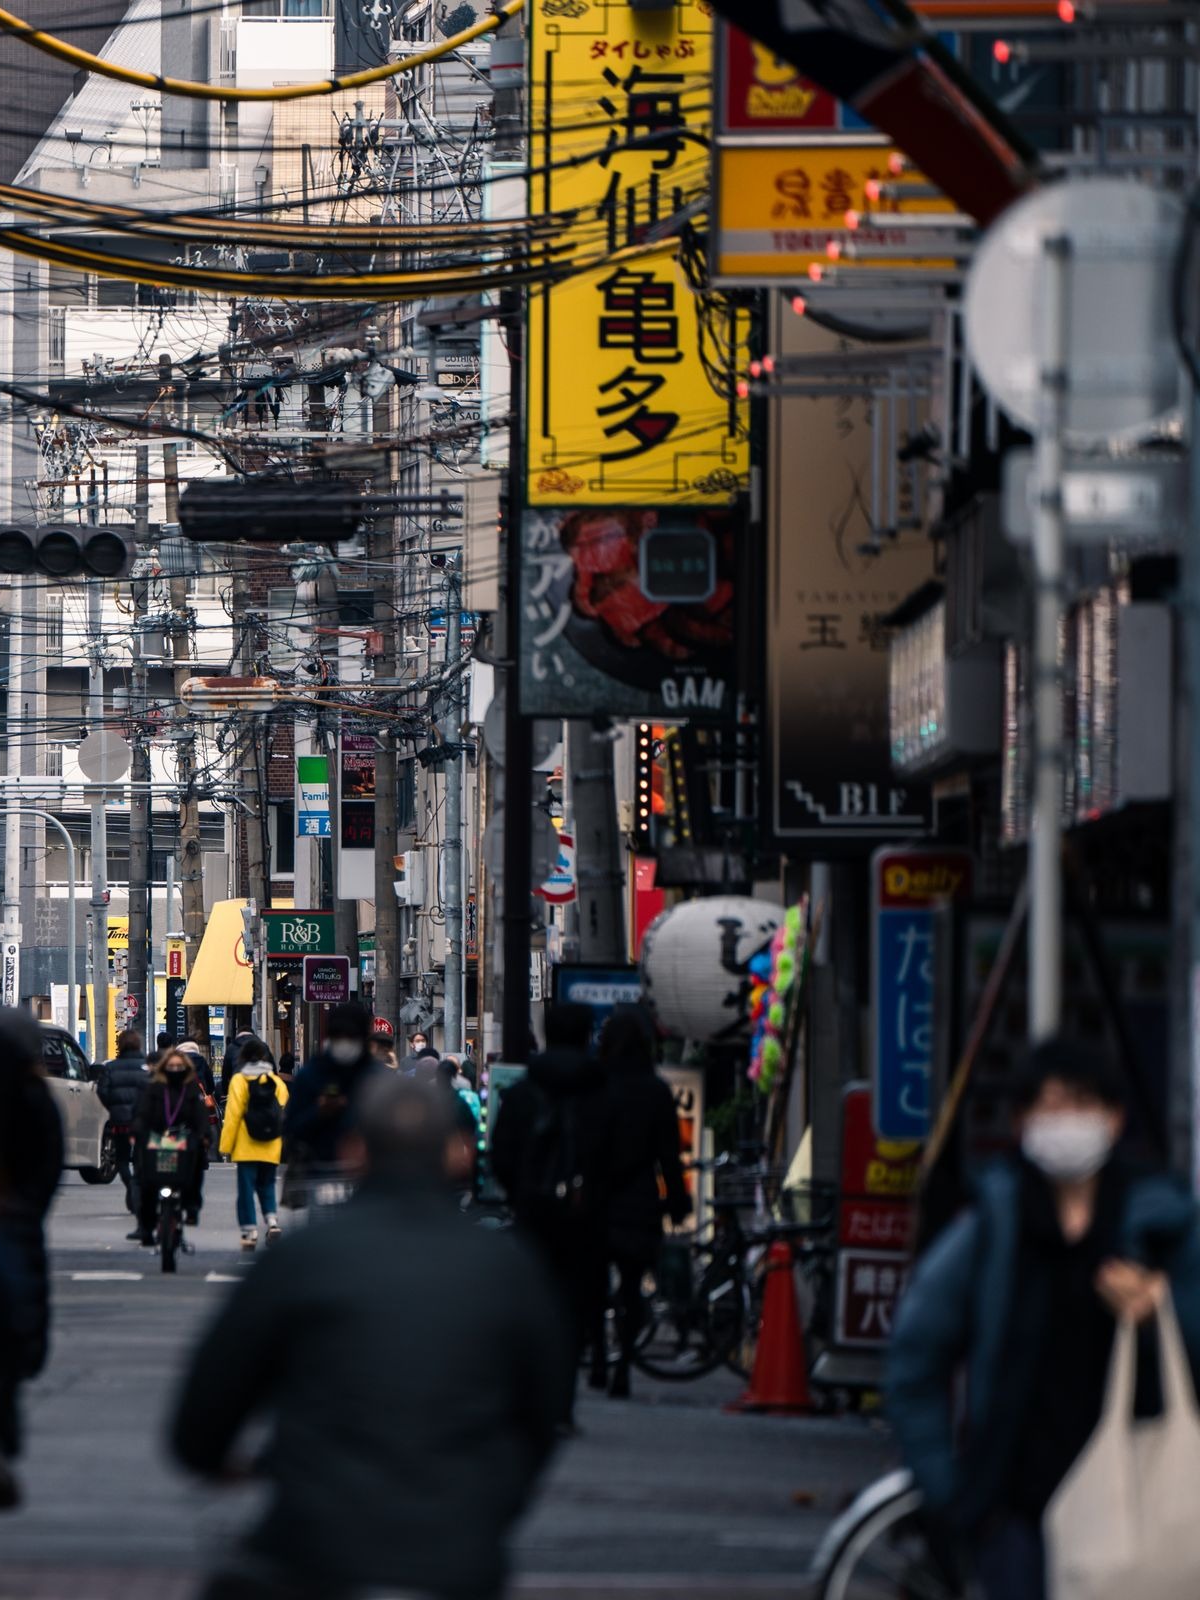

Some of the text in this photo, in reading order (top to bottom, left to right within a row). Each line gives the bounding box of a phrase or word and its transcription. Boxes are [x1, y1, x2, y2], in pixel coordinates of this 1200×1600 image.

[661, 676, 726, 709] GAM
[839, 780, 908, 818] B1F
[305, 818, 320, 834] 酒
[280, 922, 321, 945] R&B
